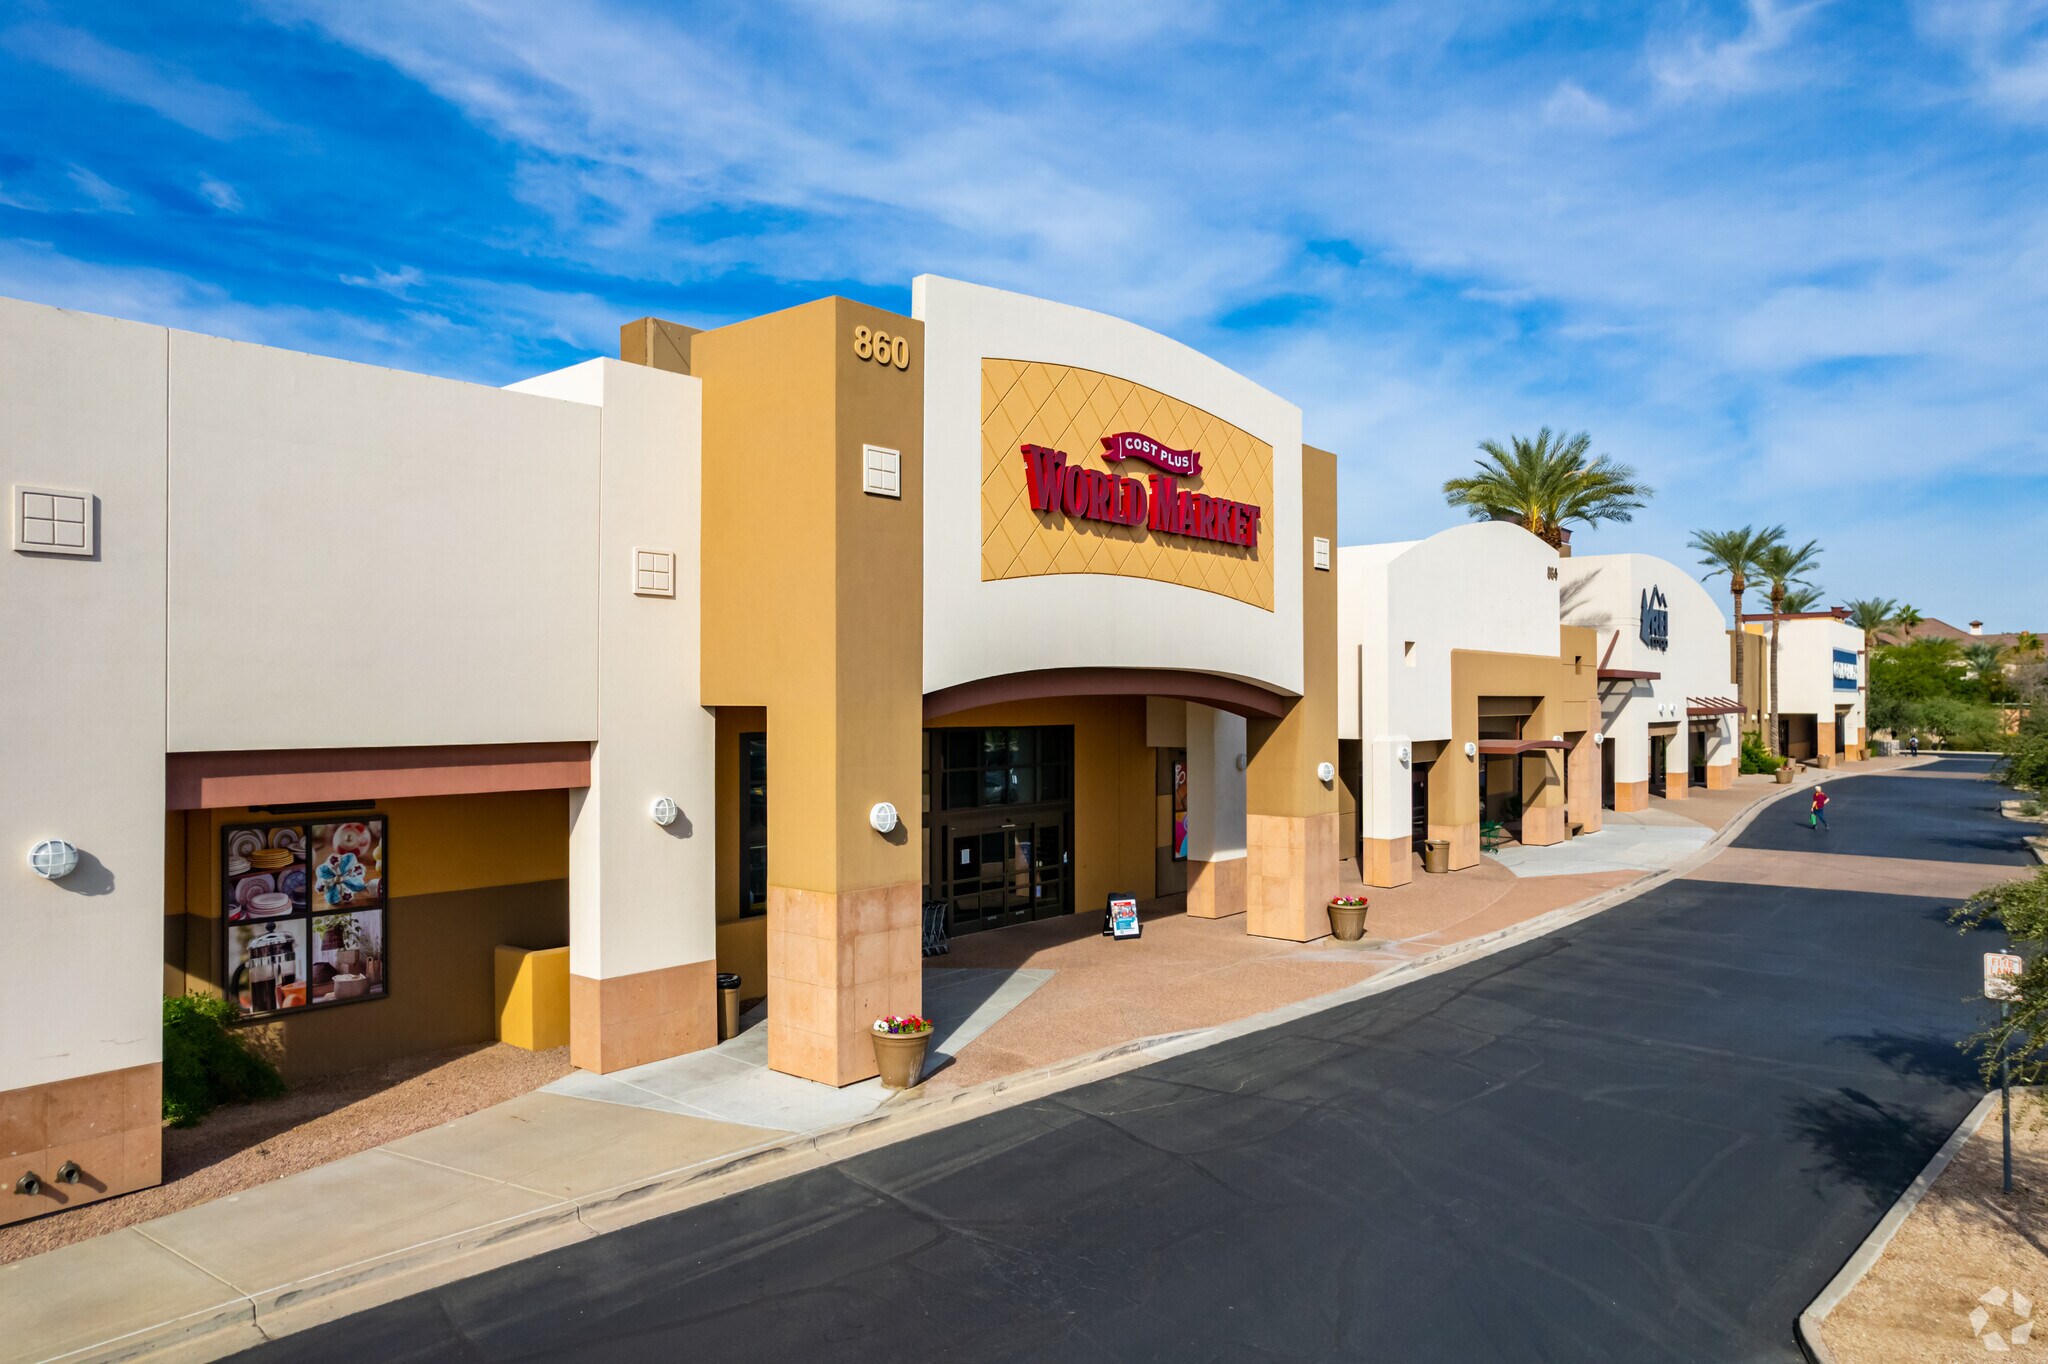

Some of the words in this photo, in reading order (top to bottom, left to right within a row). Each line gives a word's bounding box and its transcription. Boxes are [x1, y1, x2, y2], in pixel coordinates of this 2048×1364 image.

[854, 325, 910, 370] 860
[1125, 437, 1158, 457] COST
[1160, 449, 1189, 467] PLUS
[1020, 443, 1148, 527] WORLD
[1147, 473, 1261, 548] MARKET
[1991, 957, 2013, 967] FIRE
